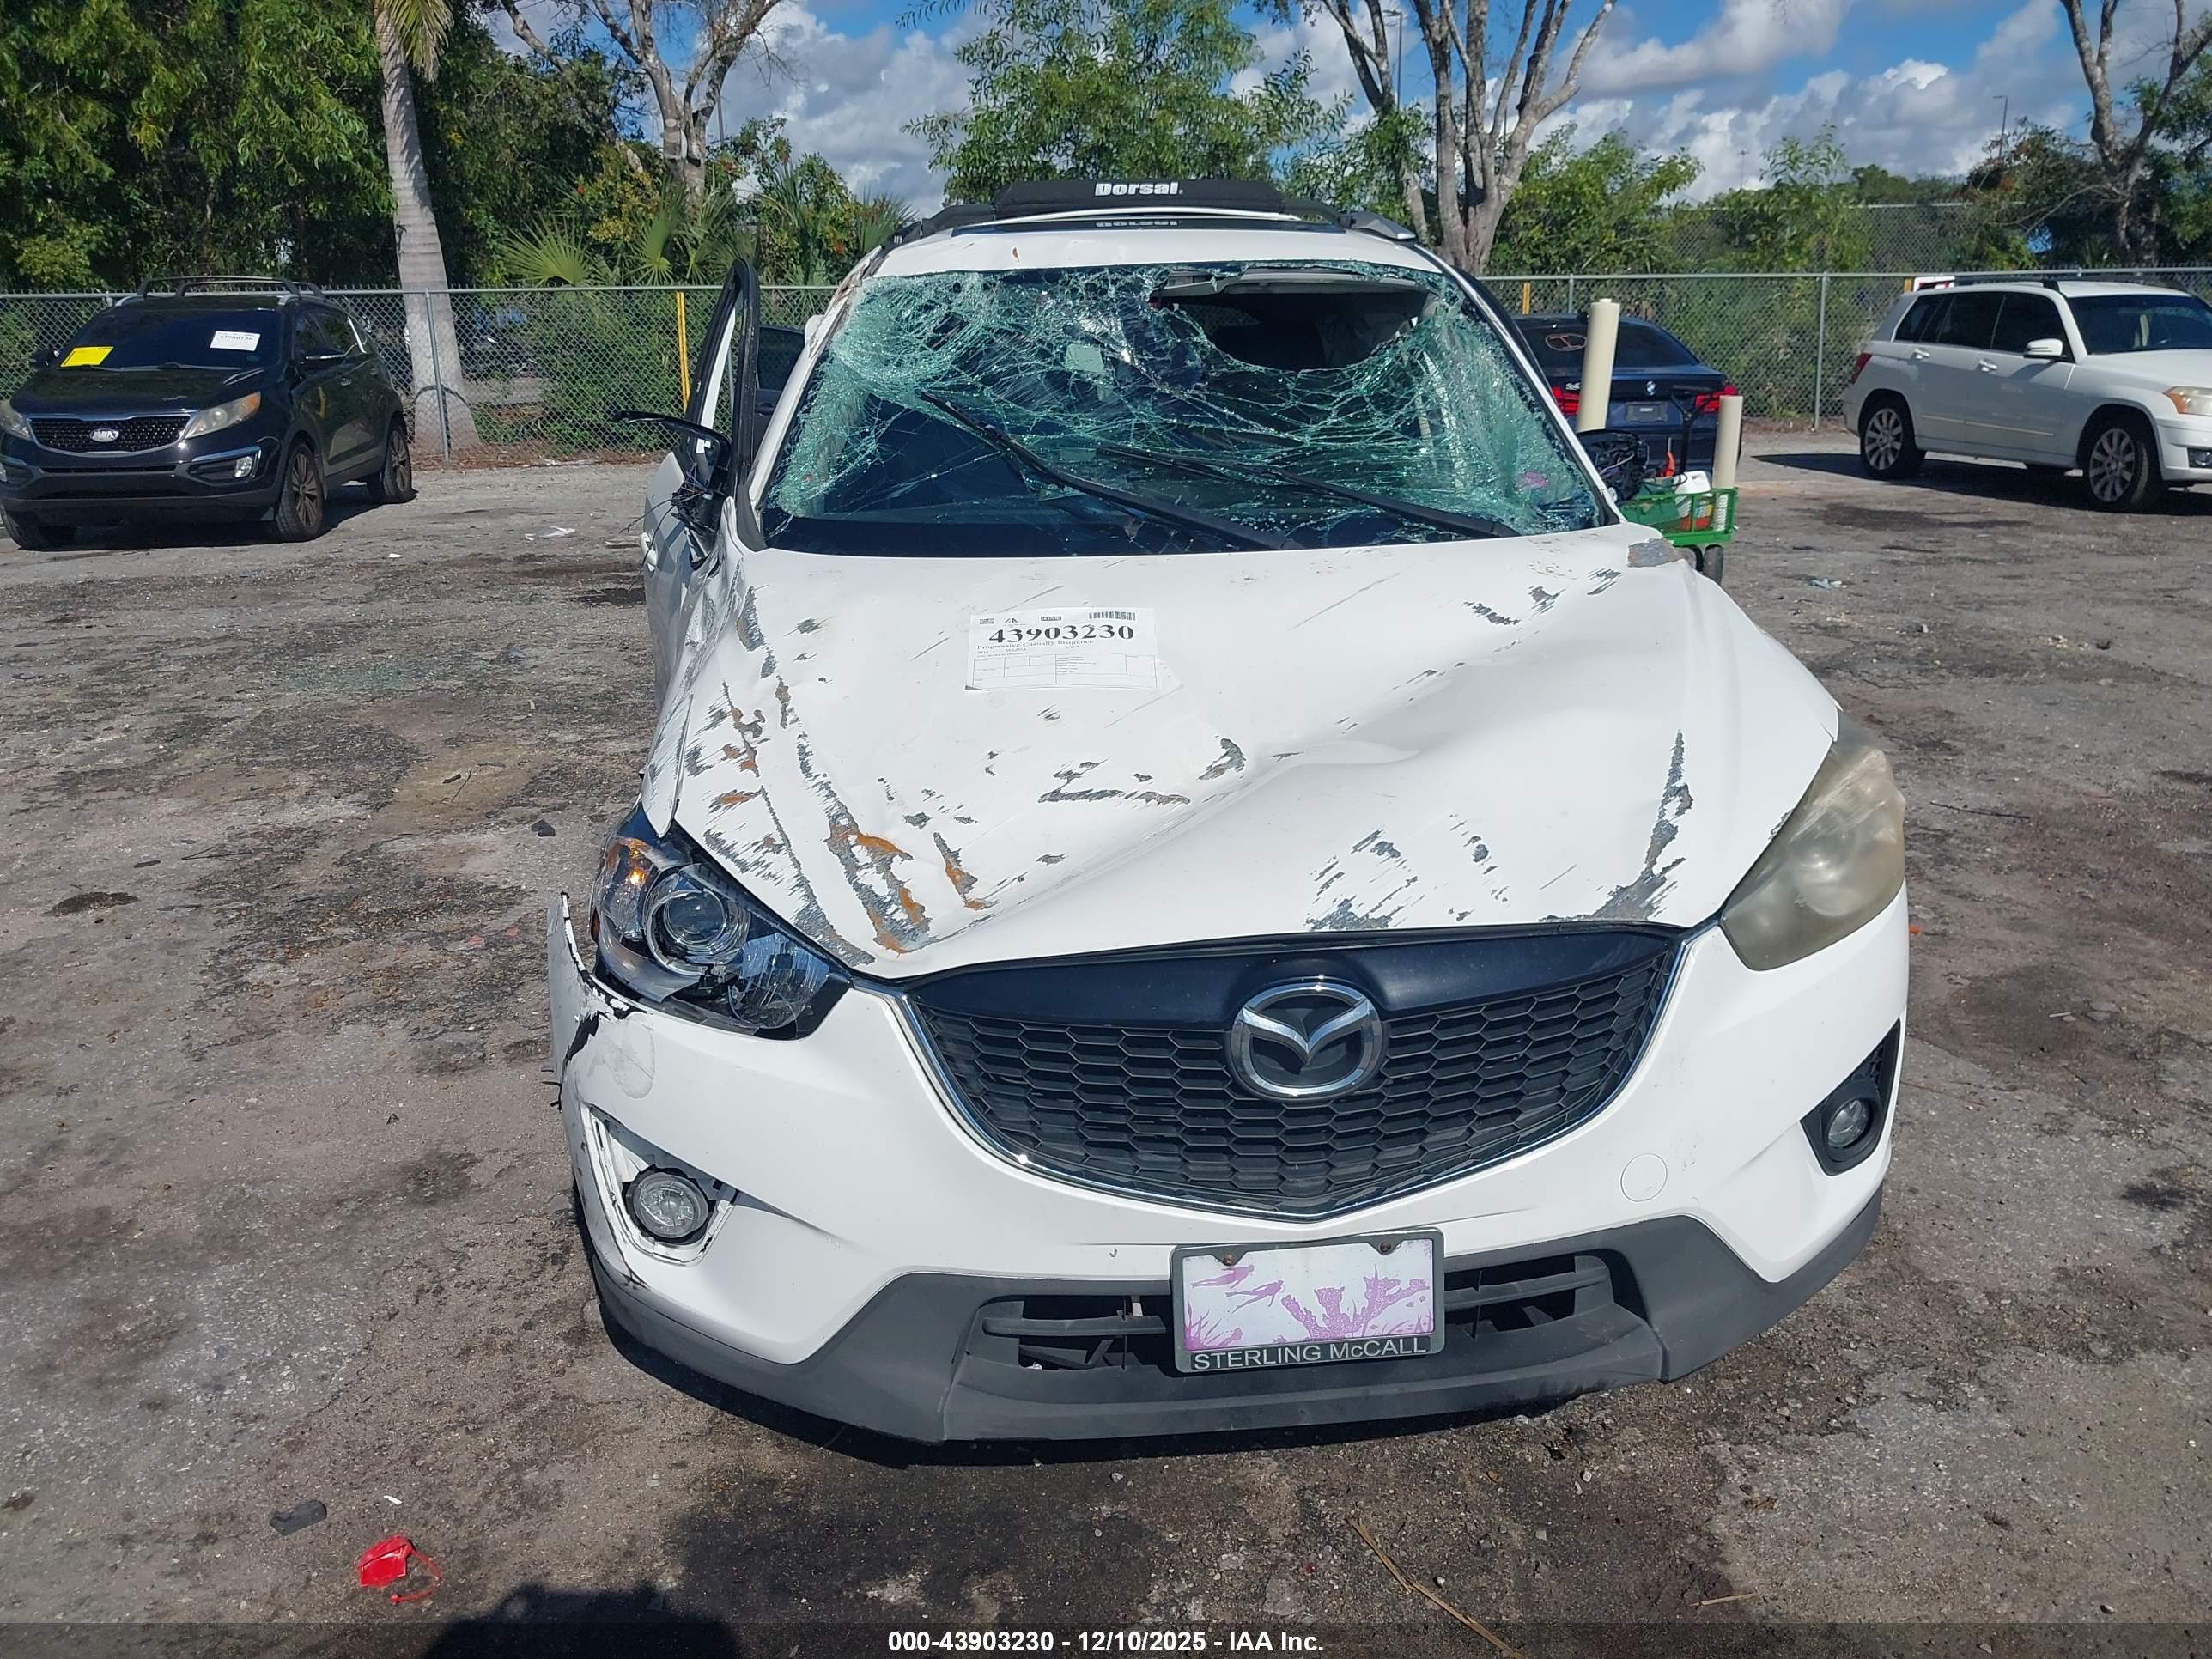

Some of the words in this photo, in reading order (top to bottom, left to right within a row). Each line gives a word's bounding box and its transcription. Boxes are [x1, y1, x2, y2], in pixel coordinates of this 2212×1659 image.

[1095, 181, 1179, 196] Dorsal
[988, 624, 1134, 643] 43903230
[1194, 1345, 1322, 1370] STERLING
[1330, 1336, 1427, 1359] McCALL
